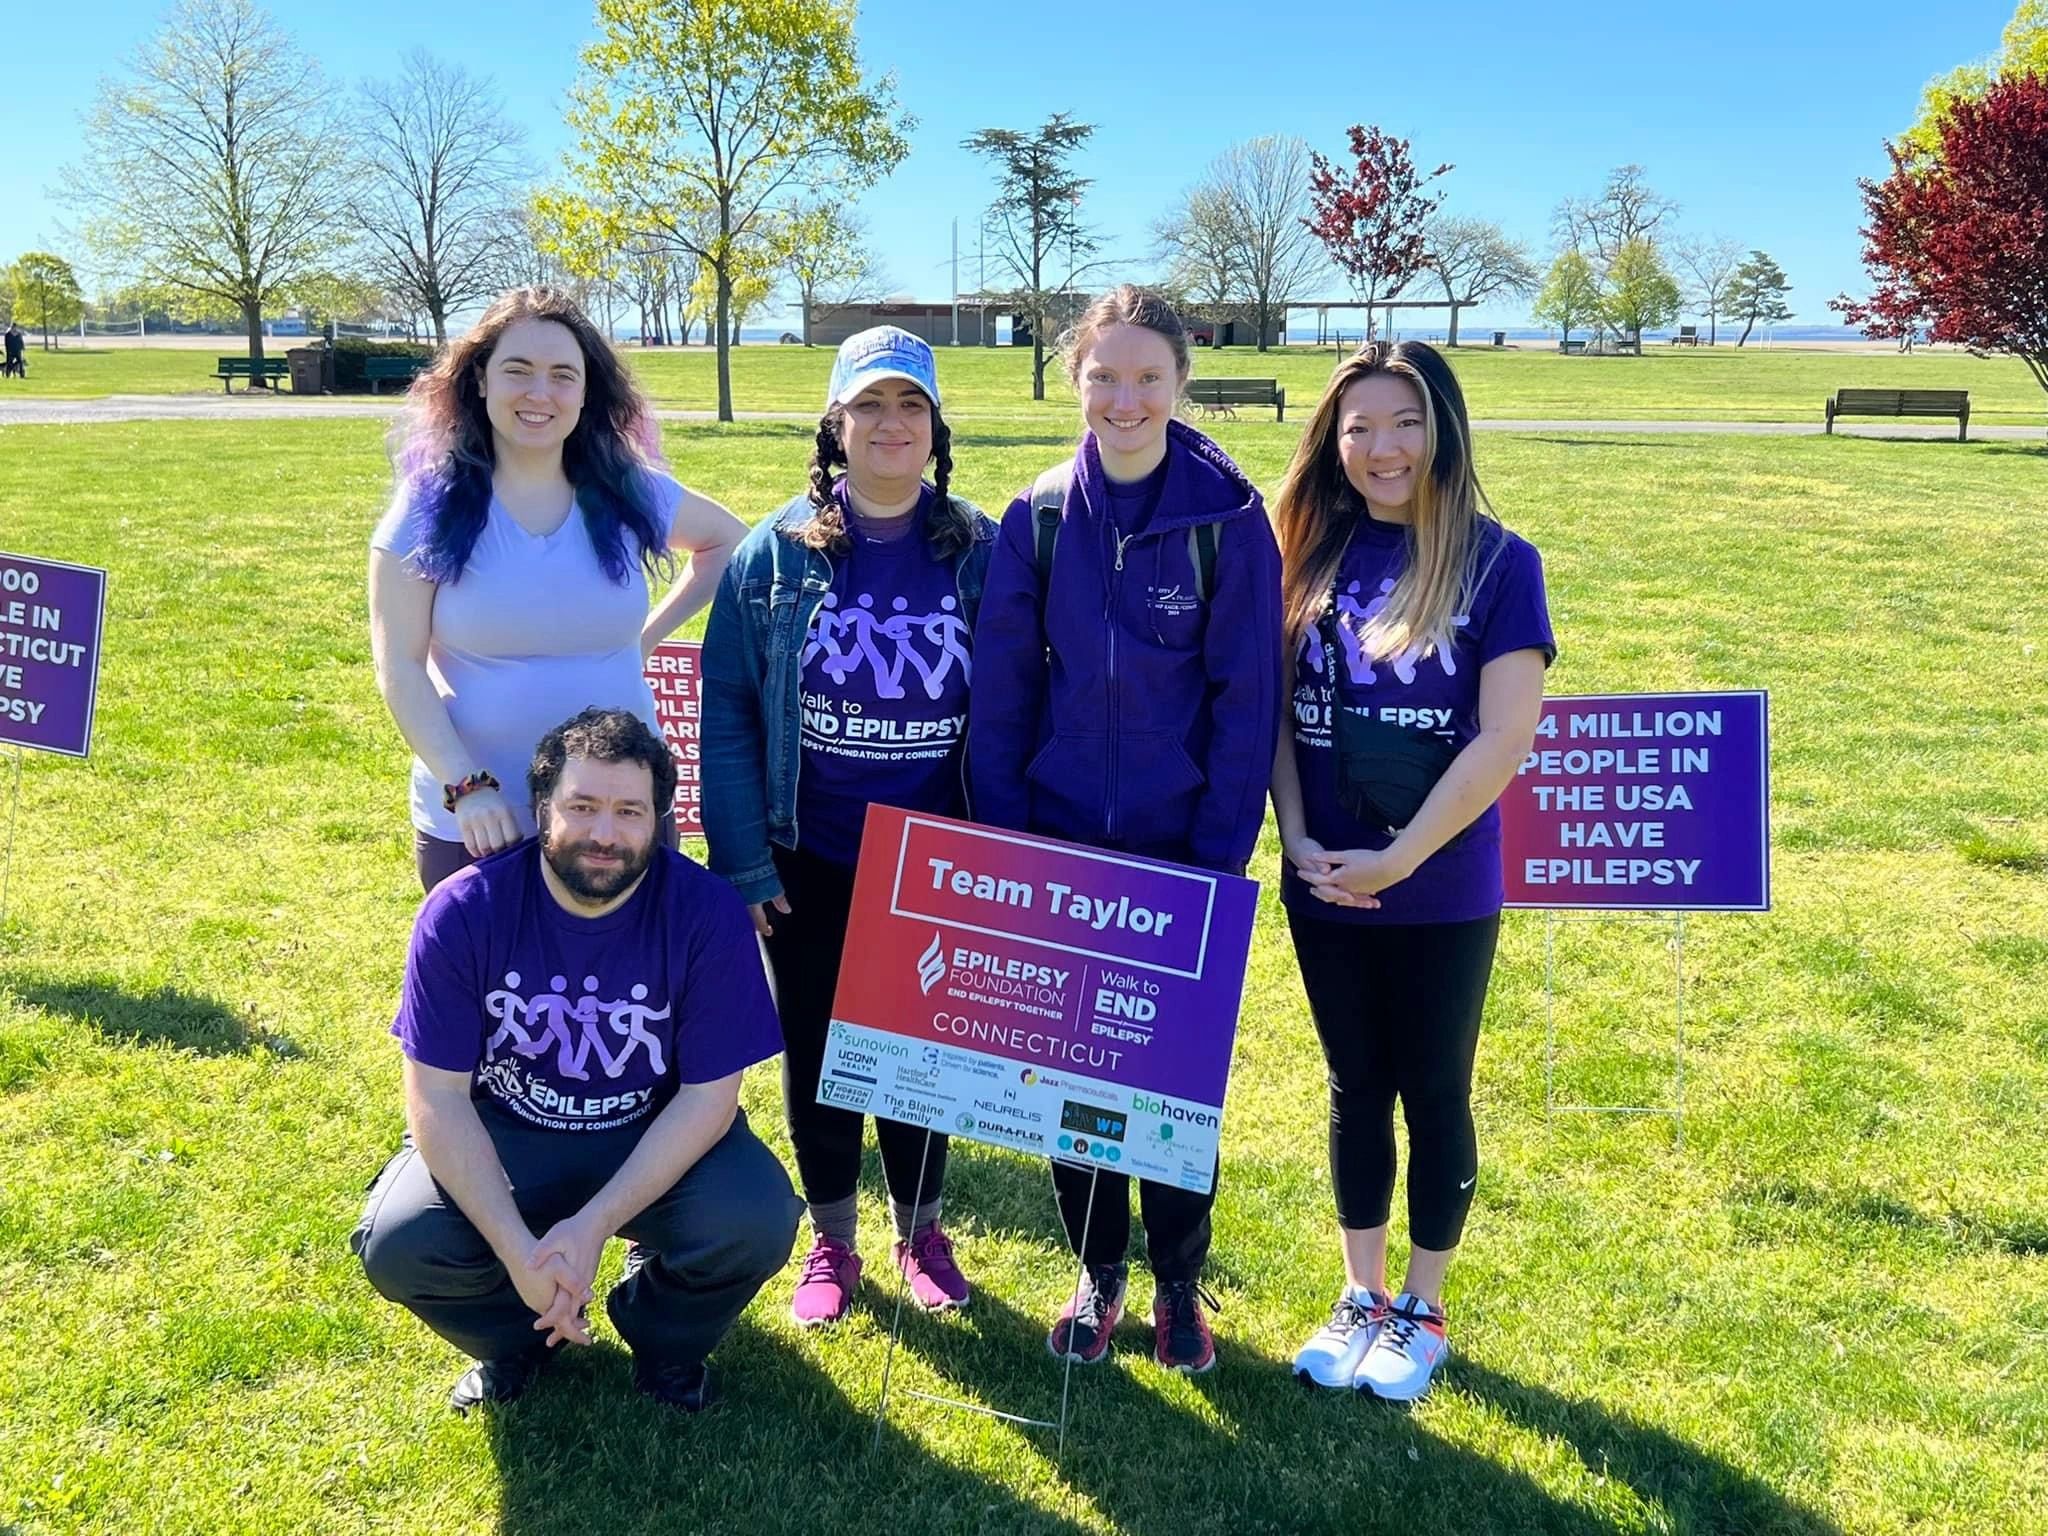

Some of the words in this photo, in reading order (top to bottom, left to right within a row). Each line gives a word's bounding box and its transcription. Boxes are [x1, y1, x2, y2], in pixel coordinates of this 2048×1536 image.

[0, 569, 40, 595] 00
[32, 605, 61, 631] IN
[642, 655, 694, 675] ERE
[645, 677, 691, 696] PLE
[842, 699, 862, 715] to
[1293, 701, 1319, 725] ND
[845, 714, 967, 741] EPILEPSY
[1569, 711, 1722, 738] MILLION
[800, 736, 824, 752] EPSY
[826, 745, 889, 761] FOUNDATION
[890, 752, 903, 760] OF
[904, 749, 950, 760] CONNECT
[1517, 749, 1660, 775] PEOPLE
[1671, 748, 1709, 774] IN
[1532, 786, 1605, 811] THE
[1615, 785, 1693, 811] USA
[1560, 822, 1665, 848] HAVE
[1524, 858, 1702, 885] EPILEPSY
[928, 858, 1033, 908] Team
[1046, 882, 1173, 937] Taylor
[952, 947, 1070, 989] EPILEPSY
[949, 968, 1066, 1007] FOUNDATION
[1101, 968, 1139, 992] Walk
[1142, 979, 1160, 996] to
[947, 987, 967, 999] END
[968, 991, 1012, 1009] EPILEPSY
[1013, 1001, 1063, 1021] TOGETHER
[1094, 988, 1157, 1022] END
[844, 1034, 909, 1059] sunovion
[932, 1012, 1123, 1071] CONNECTICUT
[1091, 1023, 1152, 1046] EPILEPSY
[838, 1049, 878, 1066] UCONN
[841, 1062, 872, 1072] HEALTH
[530, 1084, 654, 1117] EPILEPSY
[883, 1093, 905, 1107] The
[908, 1099, 945, 1117] Blaine
[974, 1099, 1043, 1122] NEURELIS
[1132, 1093, 1219, 1129] biohaven
[569, 1122, 584, 1130] OF
[892, 1107, 931, 1126] Family
